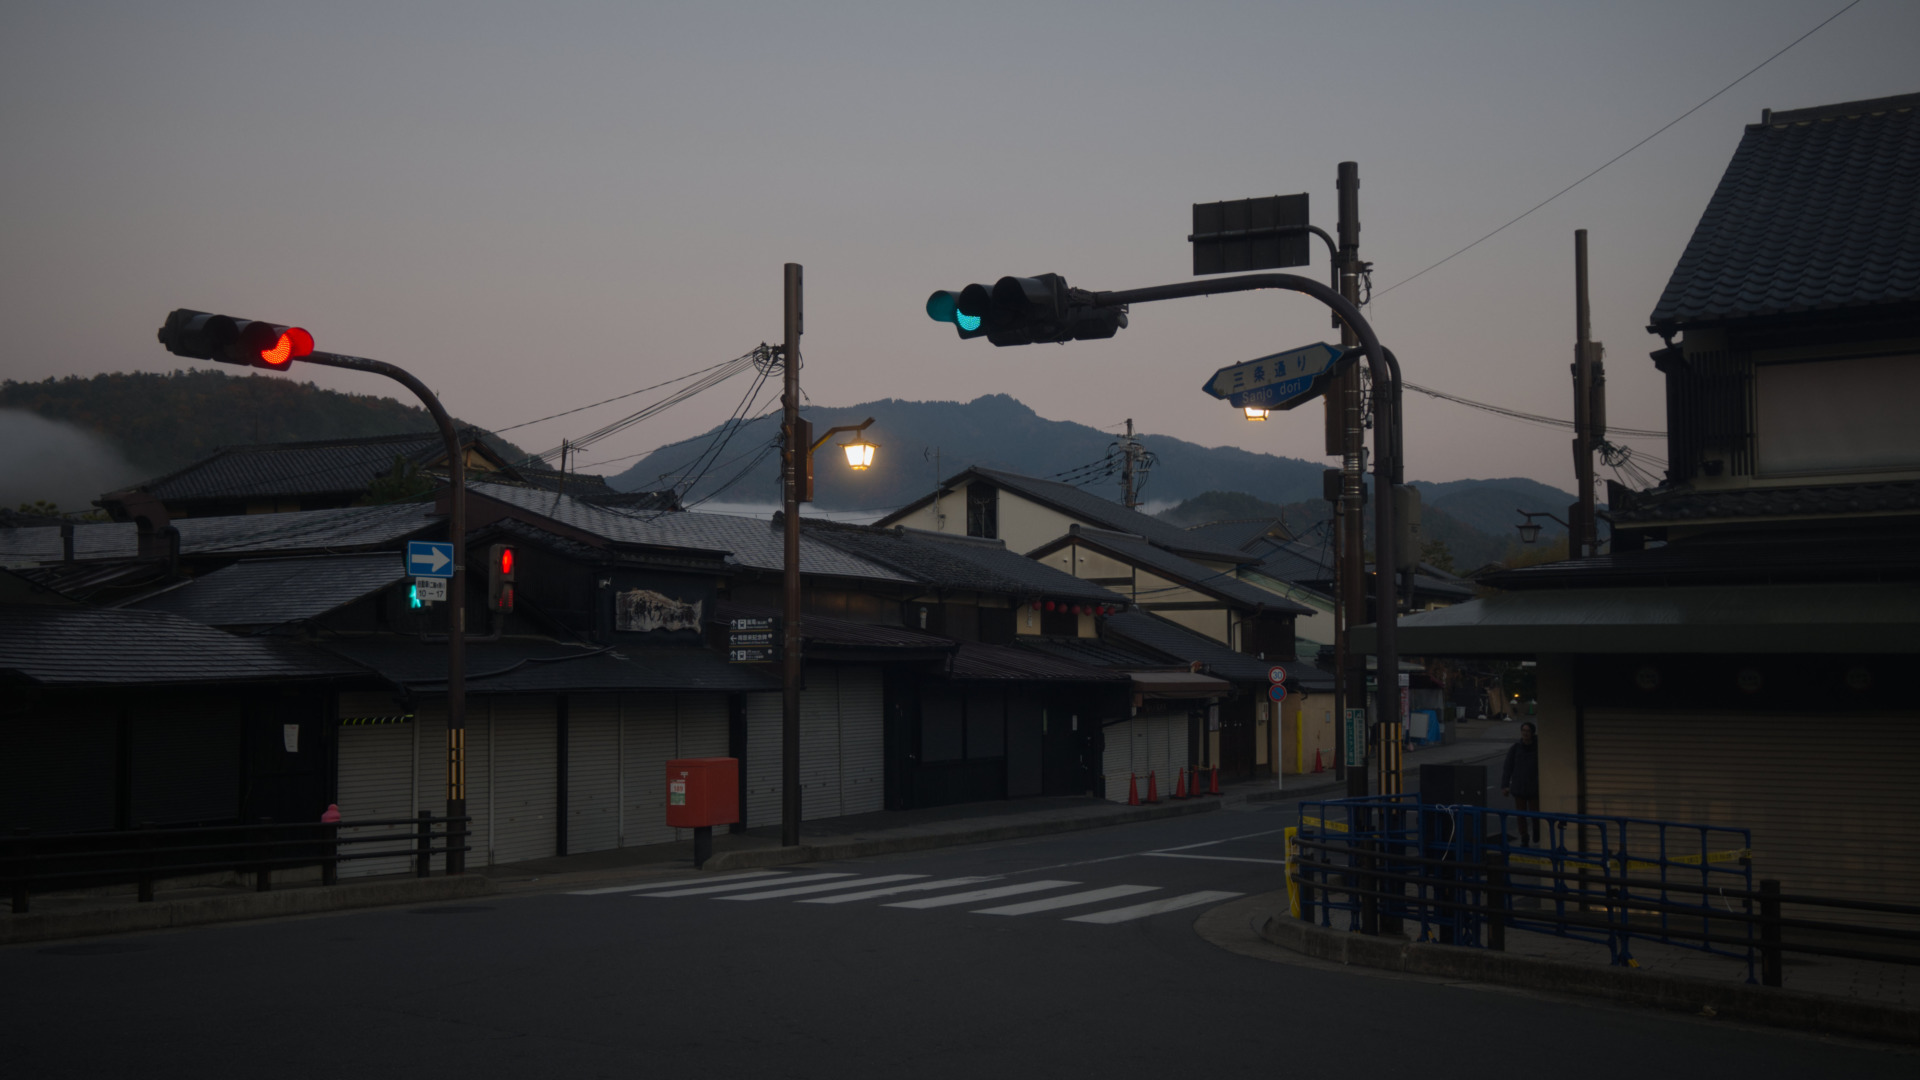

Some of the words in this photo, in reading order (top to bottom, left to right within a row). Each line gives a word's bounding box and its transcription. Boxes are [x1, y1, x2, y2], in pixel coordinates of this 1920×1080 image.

[1233, 354, 1306, 388] 三条通り
[1242, 389, 1272, 403] Sanjo
[1279, 379, 1301, 395] dori
